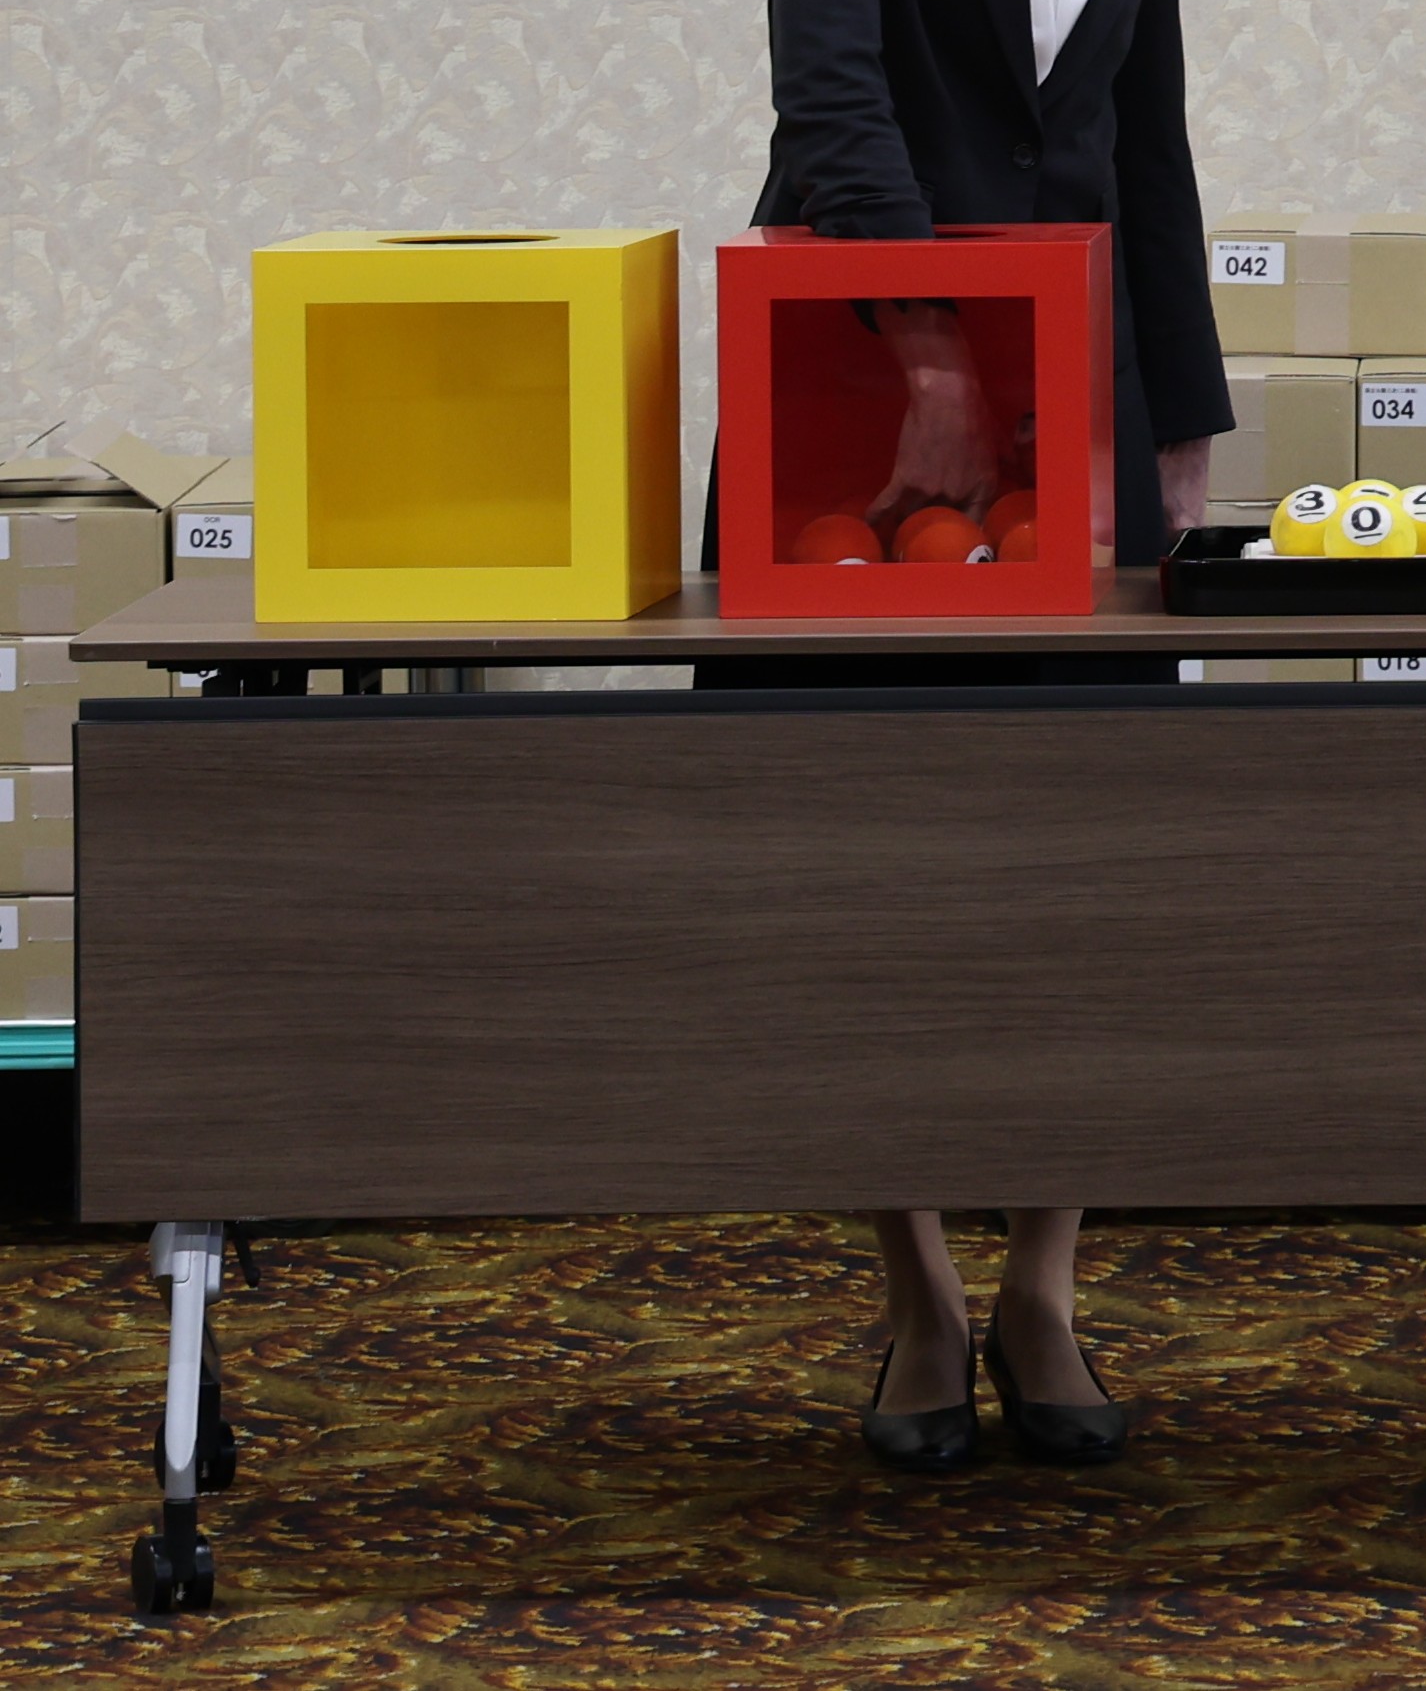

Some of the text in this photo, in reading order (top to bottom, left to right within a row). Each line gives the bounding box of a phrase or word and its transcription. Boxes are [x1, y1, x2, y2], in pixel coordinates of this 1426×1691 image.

[1225, 256, 1267, 276] 042
[1372, 399, 1414, 420] 034
[1295, 490, 1325, 511] 3
[1351, 506, 1381, 532] 0
[190, 528, 233, 549] 025
